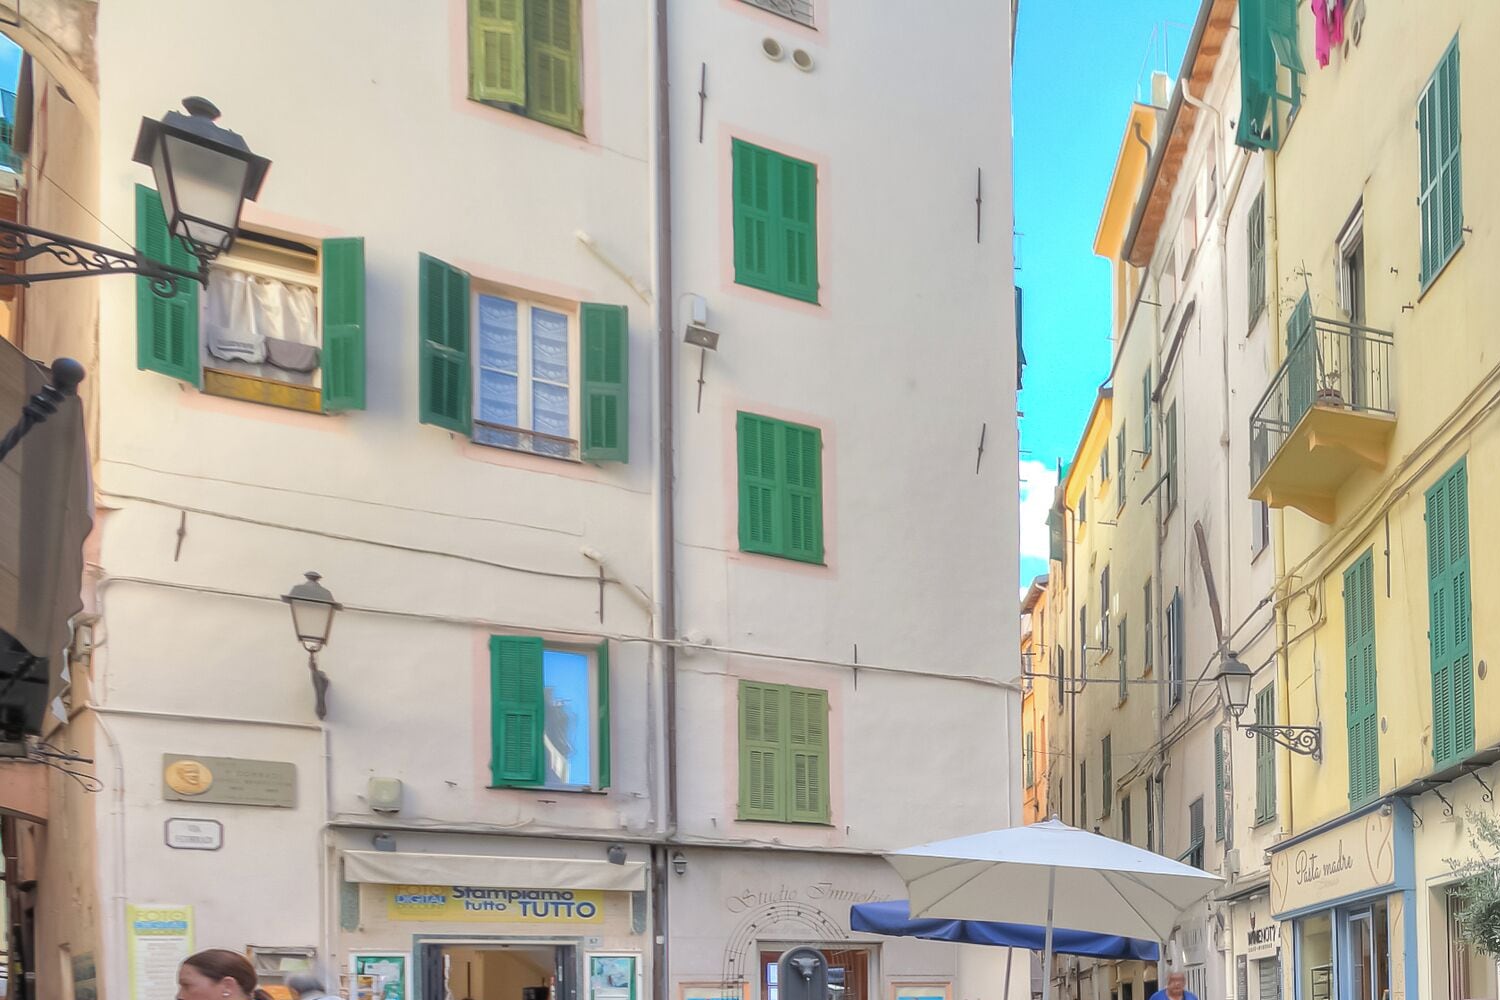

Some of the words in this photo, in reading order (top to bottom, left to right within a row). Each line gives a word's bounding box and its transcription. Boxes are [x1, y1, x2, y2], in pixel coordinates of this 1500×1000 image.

[1296, 850, 1321, 885] Pasta
[1323, 840, 1353, 876] madre
[453, 886, 574, 903] Stampiamo
[727, 884, 797, 913] Studio
[465, 900, 507, 911] tutto
[517, 901, 596, 918] TUTTO
